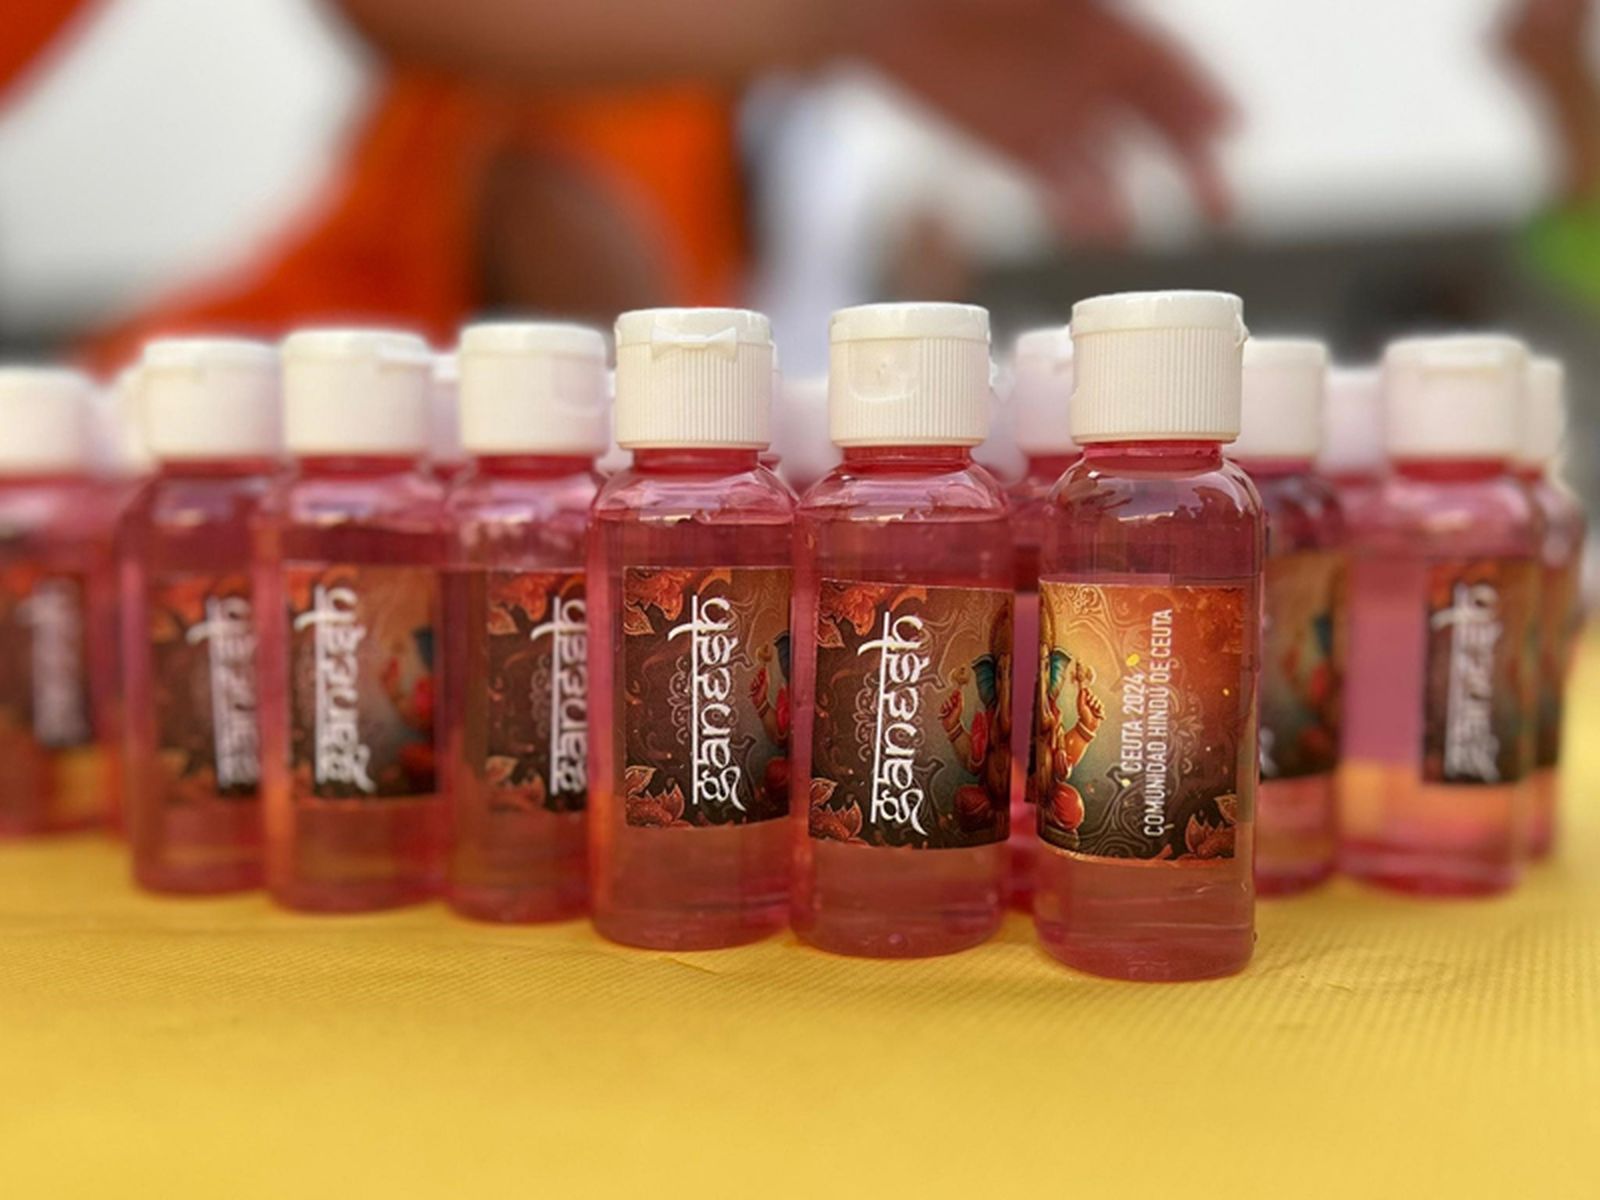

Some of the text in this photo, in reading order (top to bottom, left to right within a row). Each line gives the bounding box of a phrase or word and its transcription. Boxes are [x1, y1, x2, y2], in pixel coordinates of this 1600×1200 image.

[1150, 608, 1173, 658] CEUTA
[1150, 661, 1171, 684] DE
[1121, 672, 1146, 773] CEUTA 2024
[1143, 741, 1168, 837] COMUNIDAD
